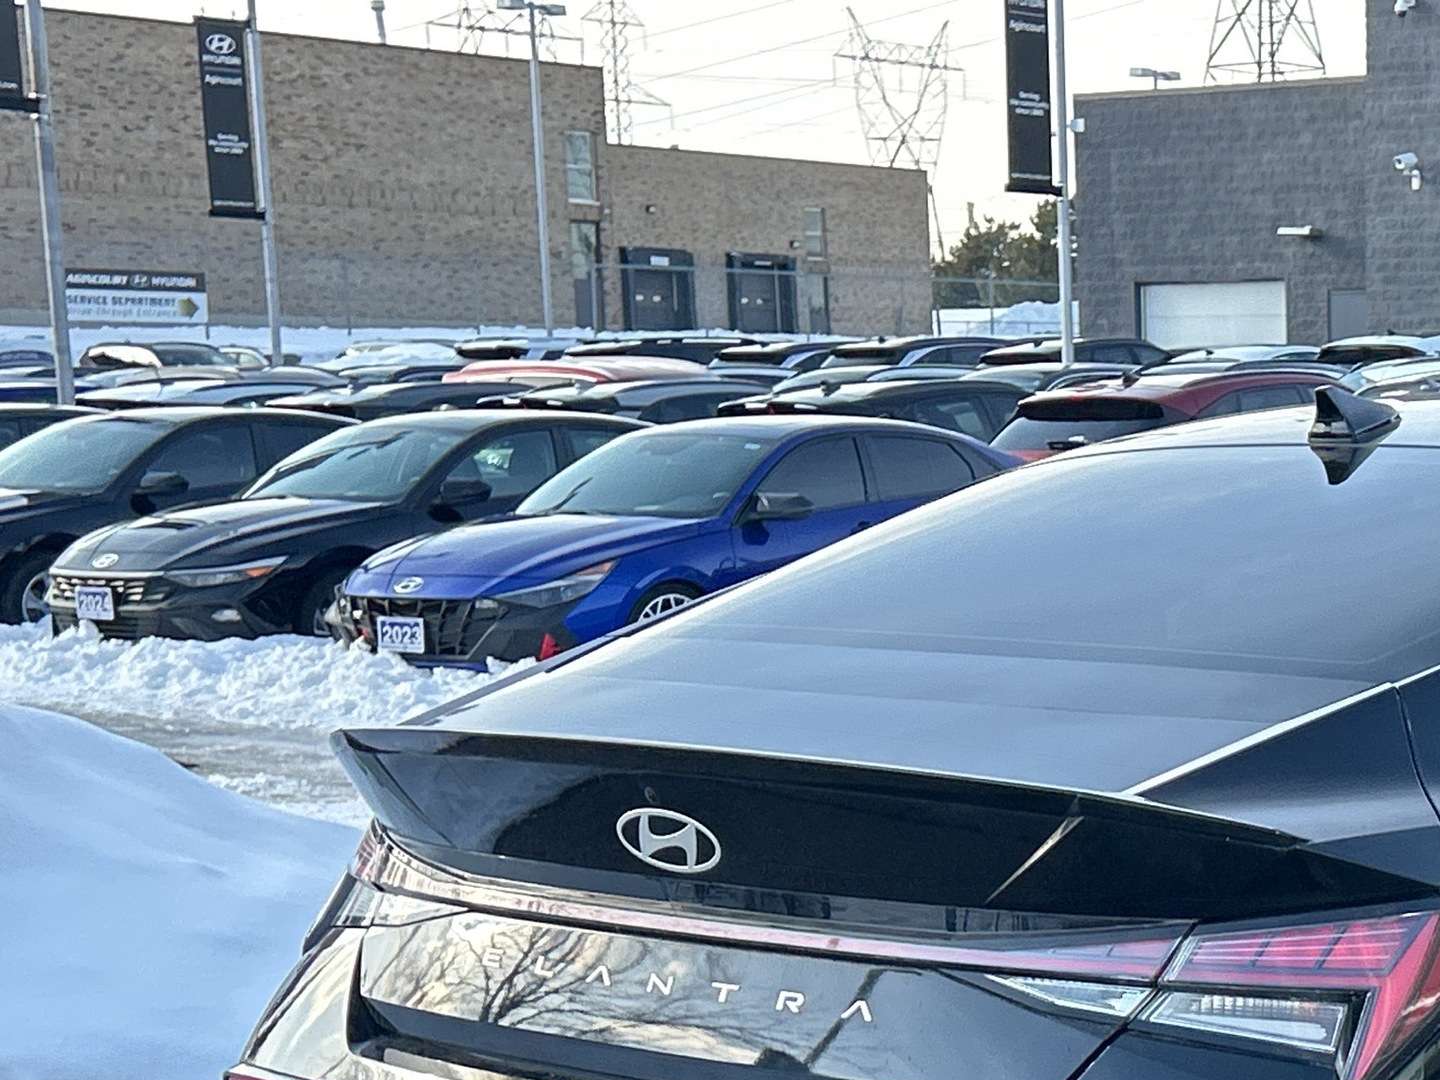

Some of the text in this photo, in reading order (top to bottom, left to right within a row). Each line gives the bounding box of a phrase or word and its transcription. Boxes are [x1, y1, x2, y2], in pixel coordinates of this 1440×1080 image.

[67, 295, 176, 307] SERVICE DEPARTMENT
[382, 625, 420, 643] 2023
[482, 947, 873, 1022] ELANTRA
